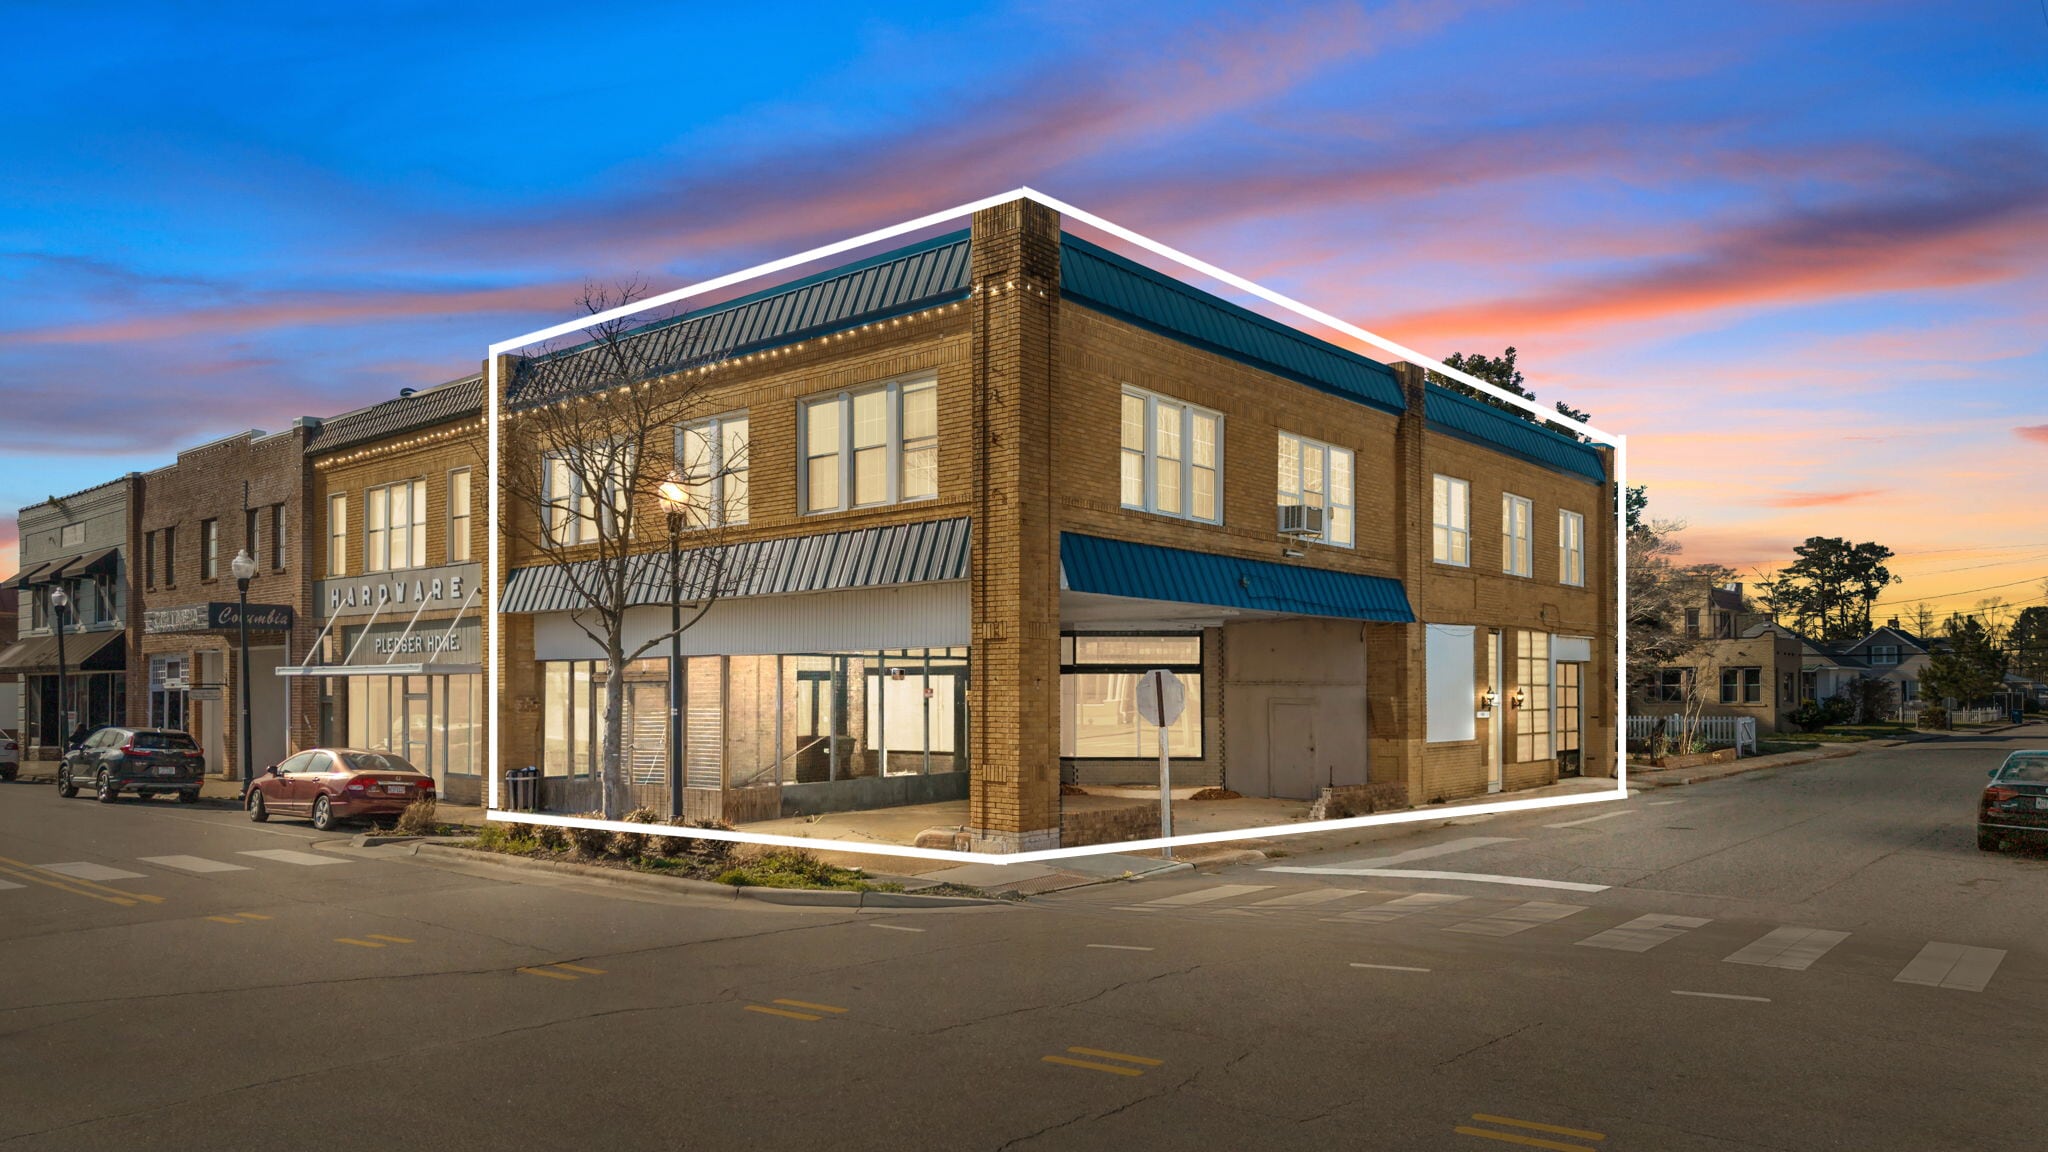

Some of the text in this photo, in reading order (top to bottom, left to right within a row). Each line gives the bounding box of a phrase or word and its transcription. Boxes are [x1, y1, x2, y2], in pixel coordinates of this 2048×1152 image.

[331, 576, 462, 608] HARDWARE
[218, 606, 289, 625] Coumbia
[375, 636, 422, 653] PLEDGER
